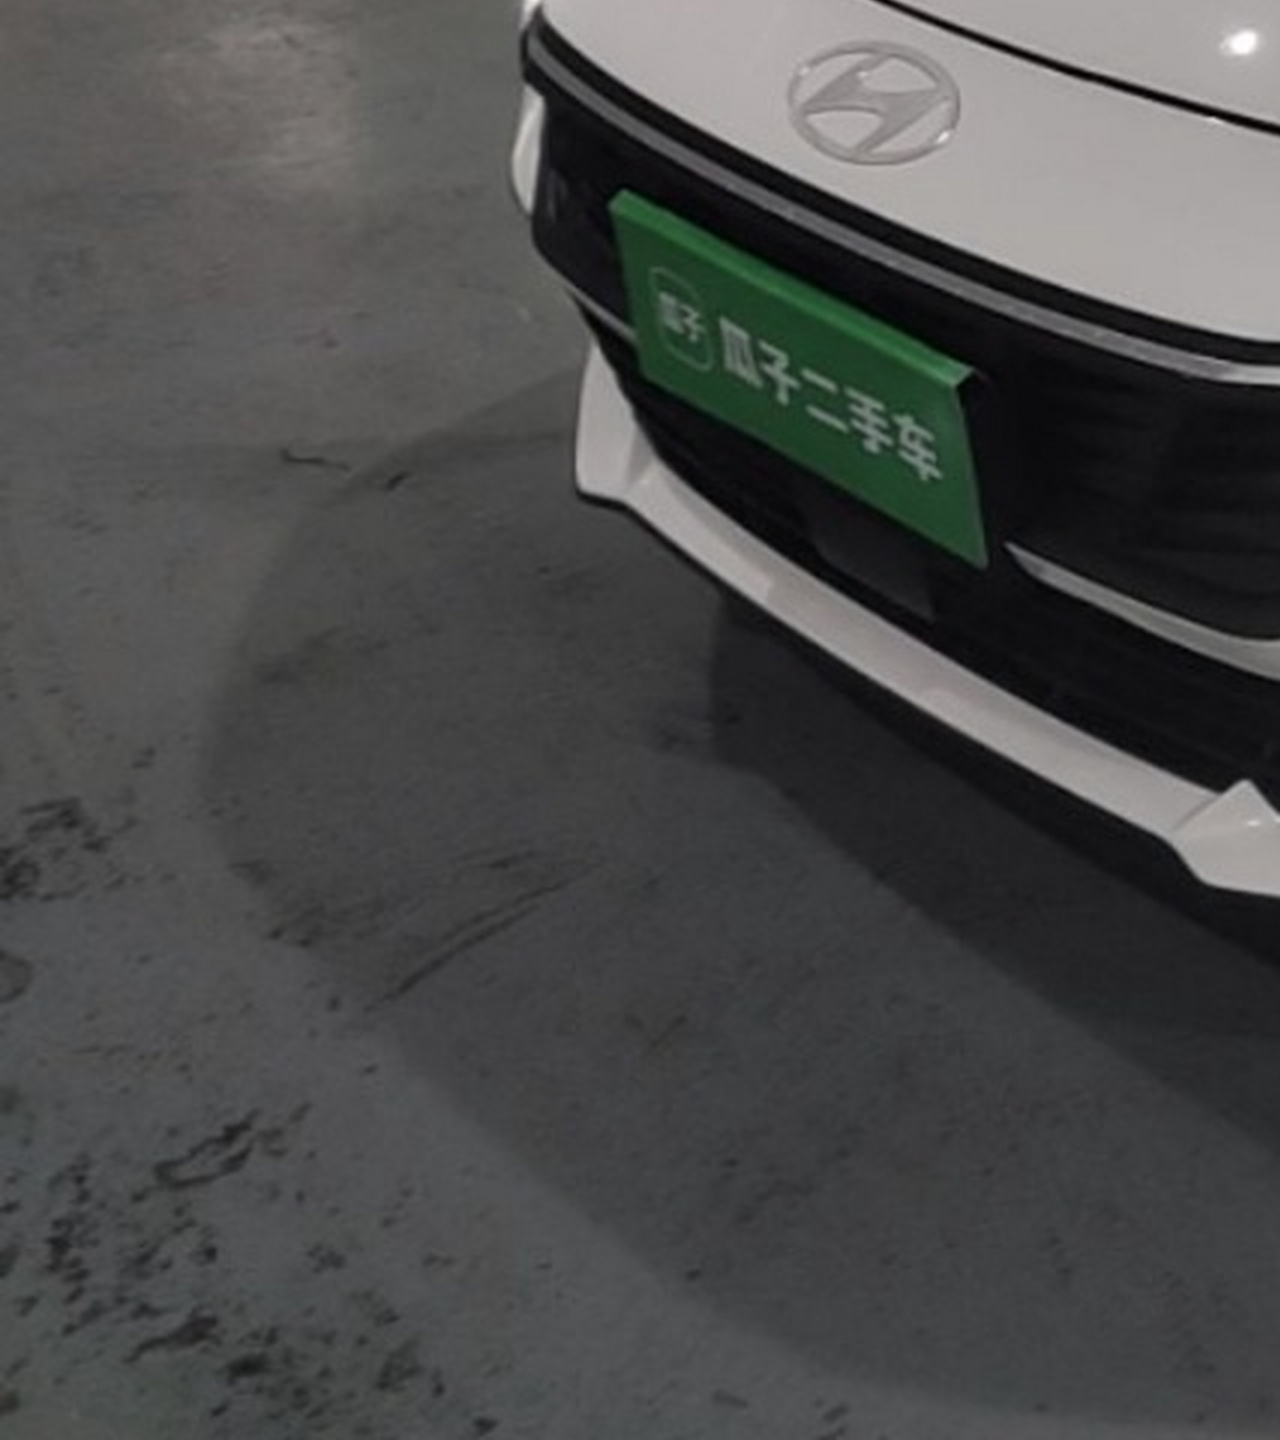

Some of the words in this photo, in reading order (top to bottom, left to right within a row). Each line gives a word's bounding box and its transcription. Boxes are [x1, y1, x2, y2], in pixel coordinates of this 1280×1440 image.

[718, 315, 943, 482] 瓜子二手车
